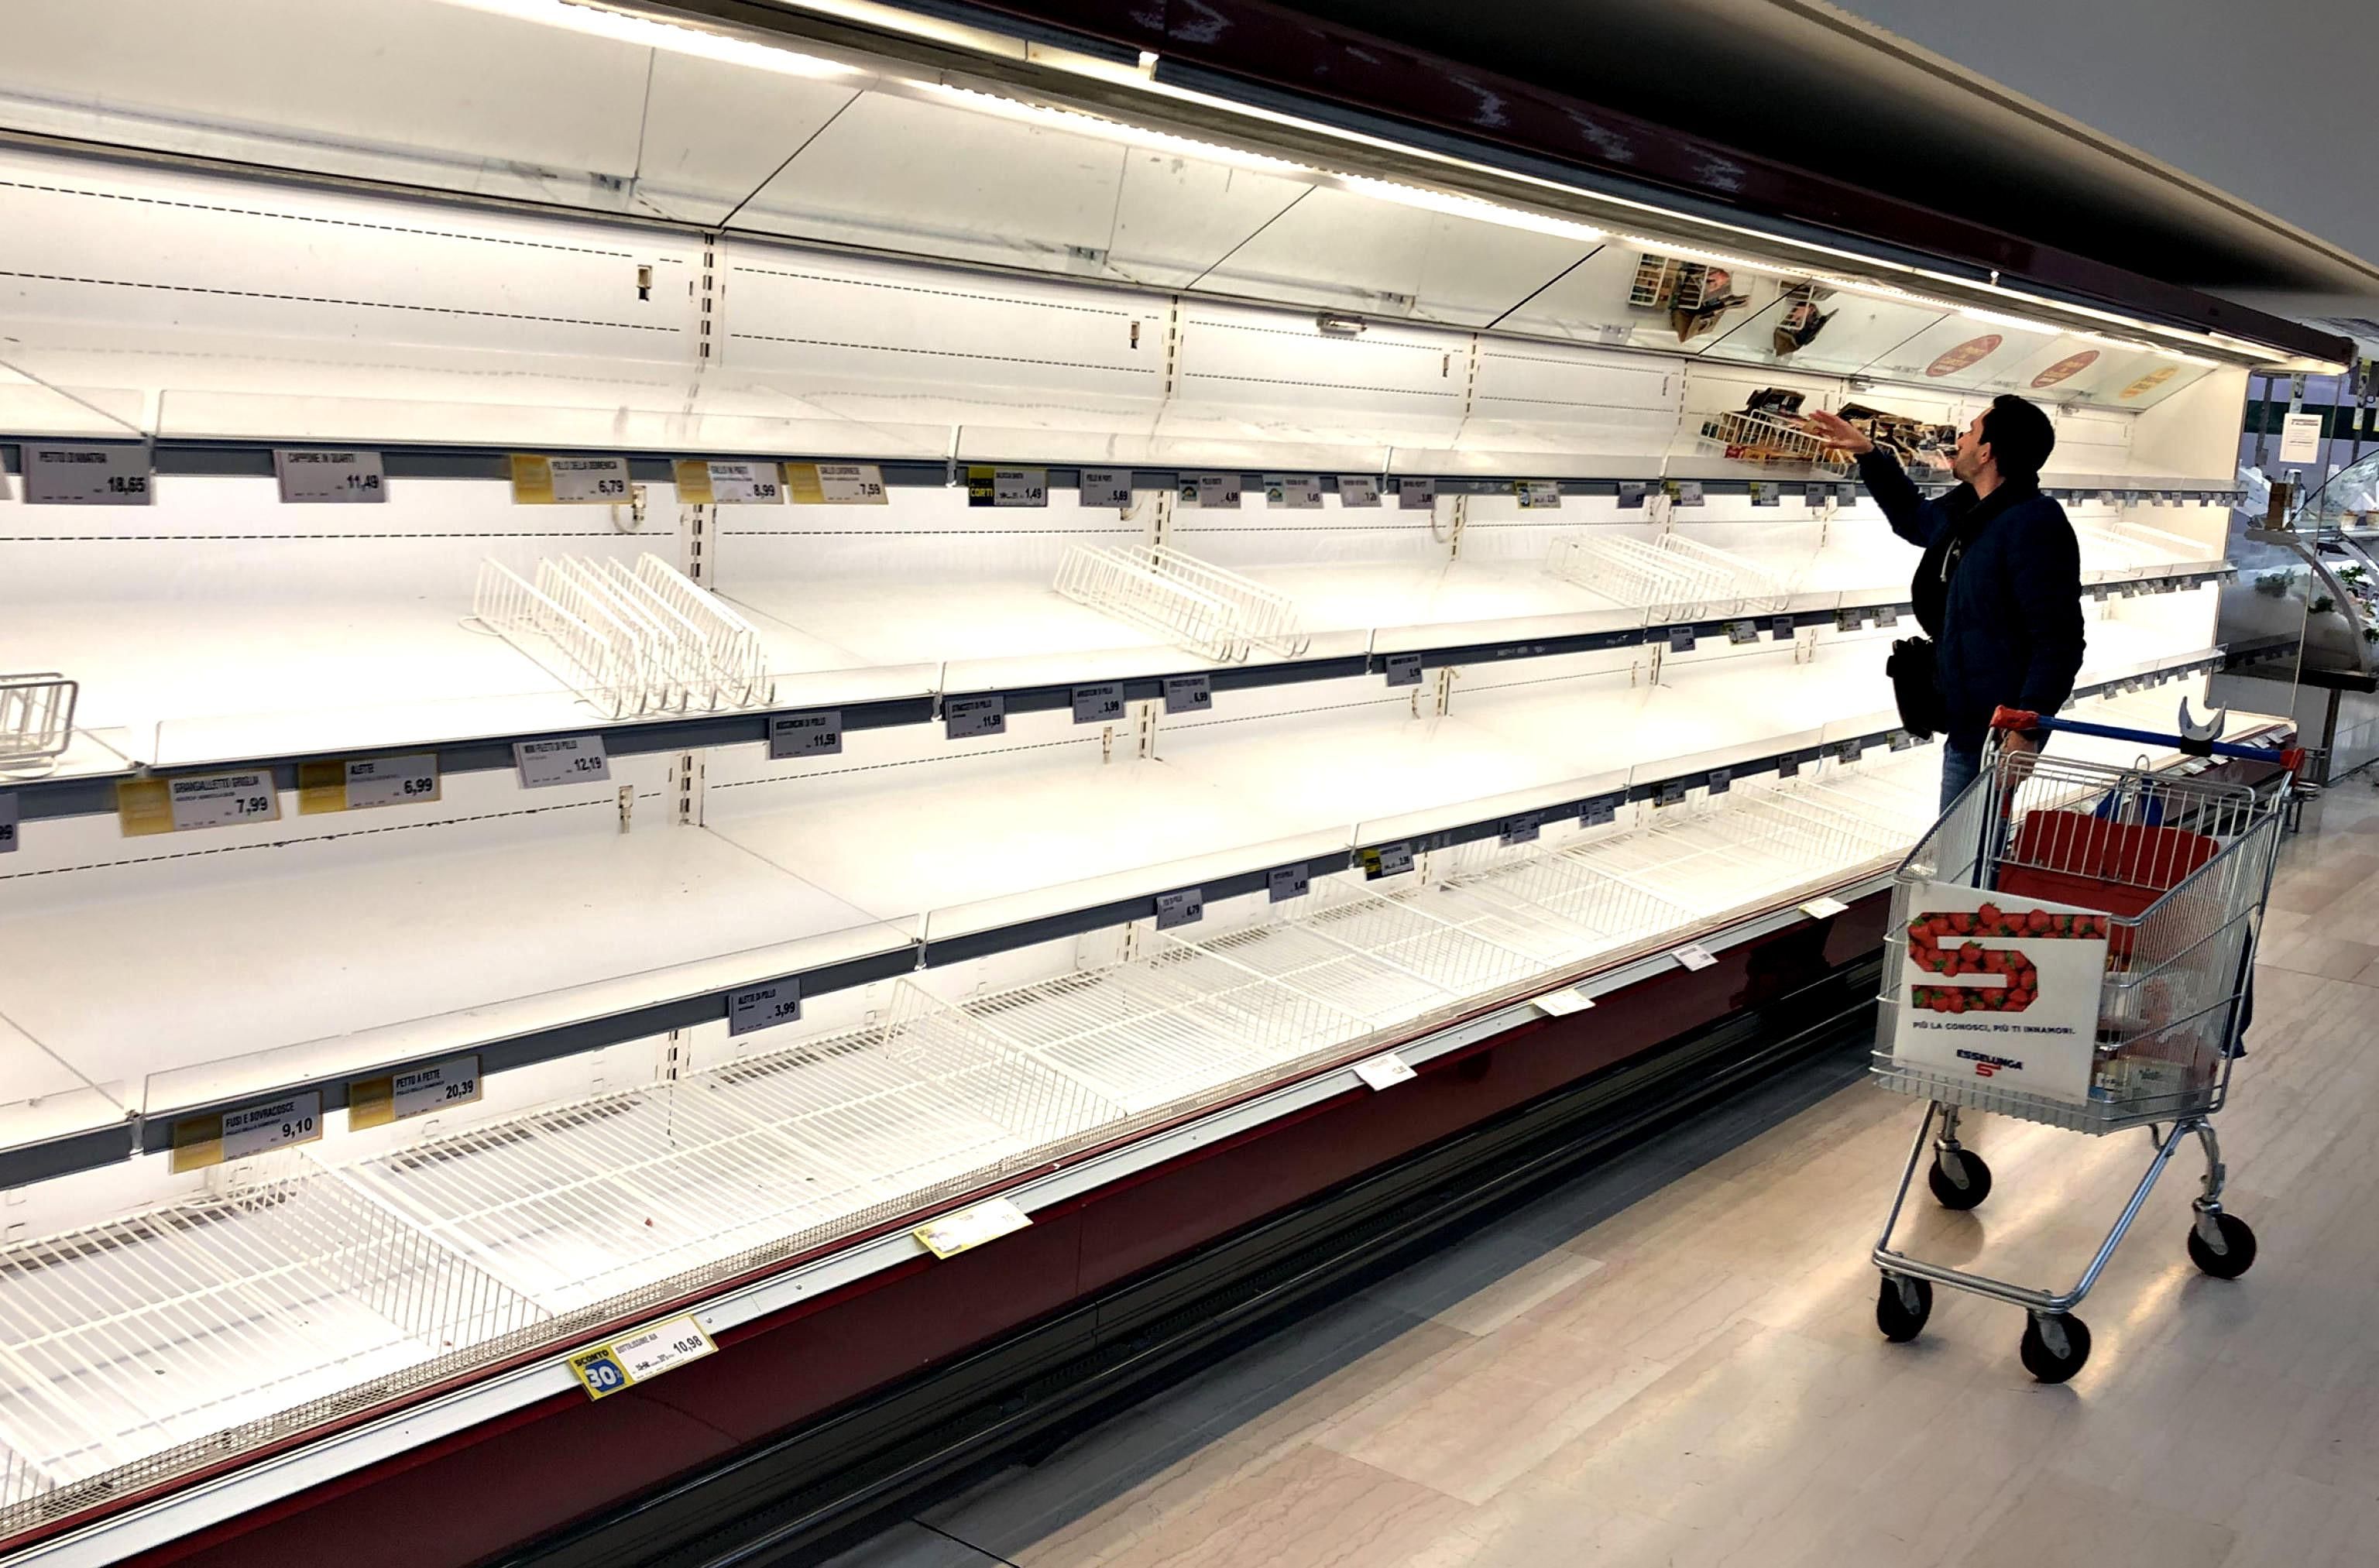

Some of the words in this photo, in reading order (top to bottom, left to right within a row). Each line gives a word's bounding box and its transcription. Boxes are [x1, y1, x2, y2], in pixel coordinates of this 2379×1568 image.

[107, 476, 146, 496] 18,65
[346, 475, 379, 492] 11,49
[598, 479, 624, 496] 6,79
[754, 484, 775, 499] 8,99
[859, 484, 881, 497] 7,59
[1025, 488, 1042, 500] 1,49
[813, 733, 836, 746] 11,59
[350, 763, 374, 775] ALETTE
[574, 757, 602, 773] 12,19
[403, 778, 433, 796] 6,99
[235, 797, 268, 815] 7,99
[774, 1001, 796, 1018] 3,99
[1913, 1021, 1928, 1029] PIÙ
[1945, 1023, 1991, 1032] CONOSCI,
[1993, 1024, 2009, 1032] PIÙ
[2024, 1026, 2076, 1034] INNAMORI.
[1956, 1048, 2023, 1070] ESSELUNGA
[396, 1072, 415, 1088] PETTO
[417, 1073, 422, 1084] A
[422, 1069, 441, 1082] FETTE
[445, 1079, 474, 1100] 20,39
[225, 1117, 242, 1127] FUSI
[243, 1113, 249, 1124] E
[250, 1102, 295, 1122] SOVRACOSCE
[282, 1117, 313, 1139] 9,10
[673, 1336, 703, 1355] 10,98
[574, 1350, 609, 1367] SCONTO
